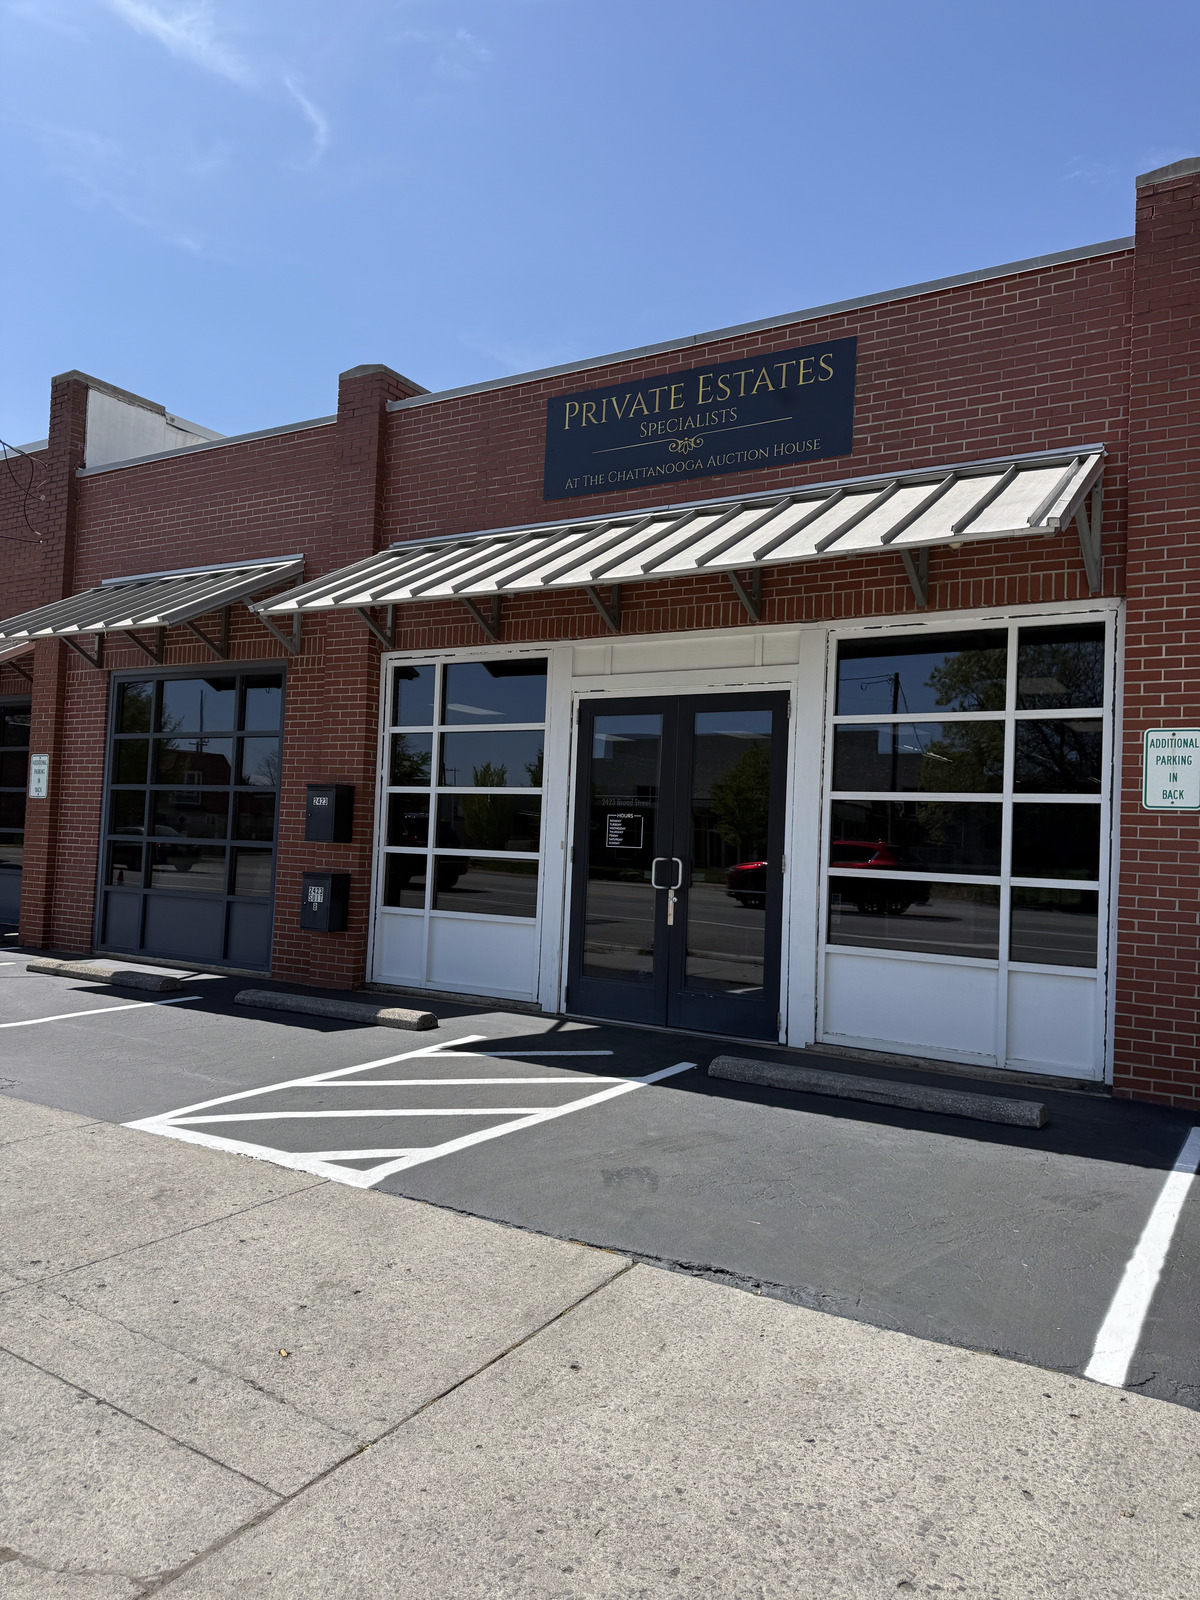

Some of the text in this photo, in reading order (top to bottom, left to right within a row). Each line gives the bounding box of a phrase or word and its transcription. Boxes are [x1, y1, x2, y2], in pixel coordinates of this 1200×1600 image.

[563, 352, 834, 430] PRIVATE ESTATES
[639, 406, 738, 438] SPECIALISTS
[564, 438, 822, 490] AT THE CHATTANOOGA AUCTION HOUSE
[1149, 737, 1200, 749] ADDITIONAL
[1155, 755, 1193, 766] PARKING
[1169, 772, 1178, 782] IN
[1162, 789, 1185, 800] BACK
[313, 796, 329, 806] 2423
[308, 886, 324, 895] 2423
